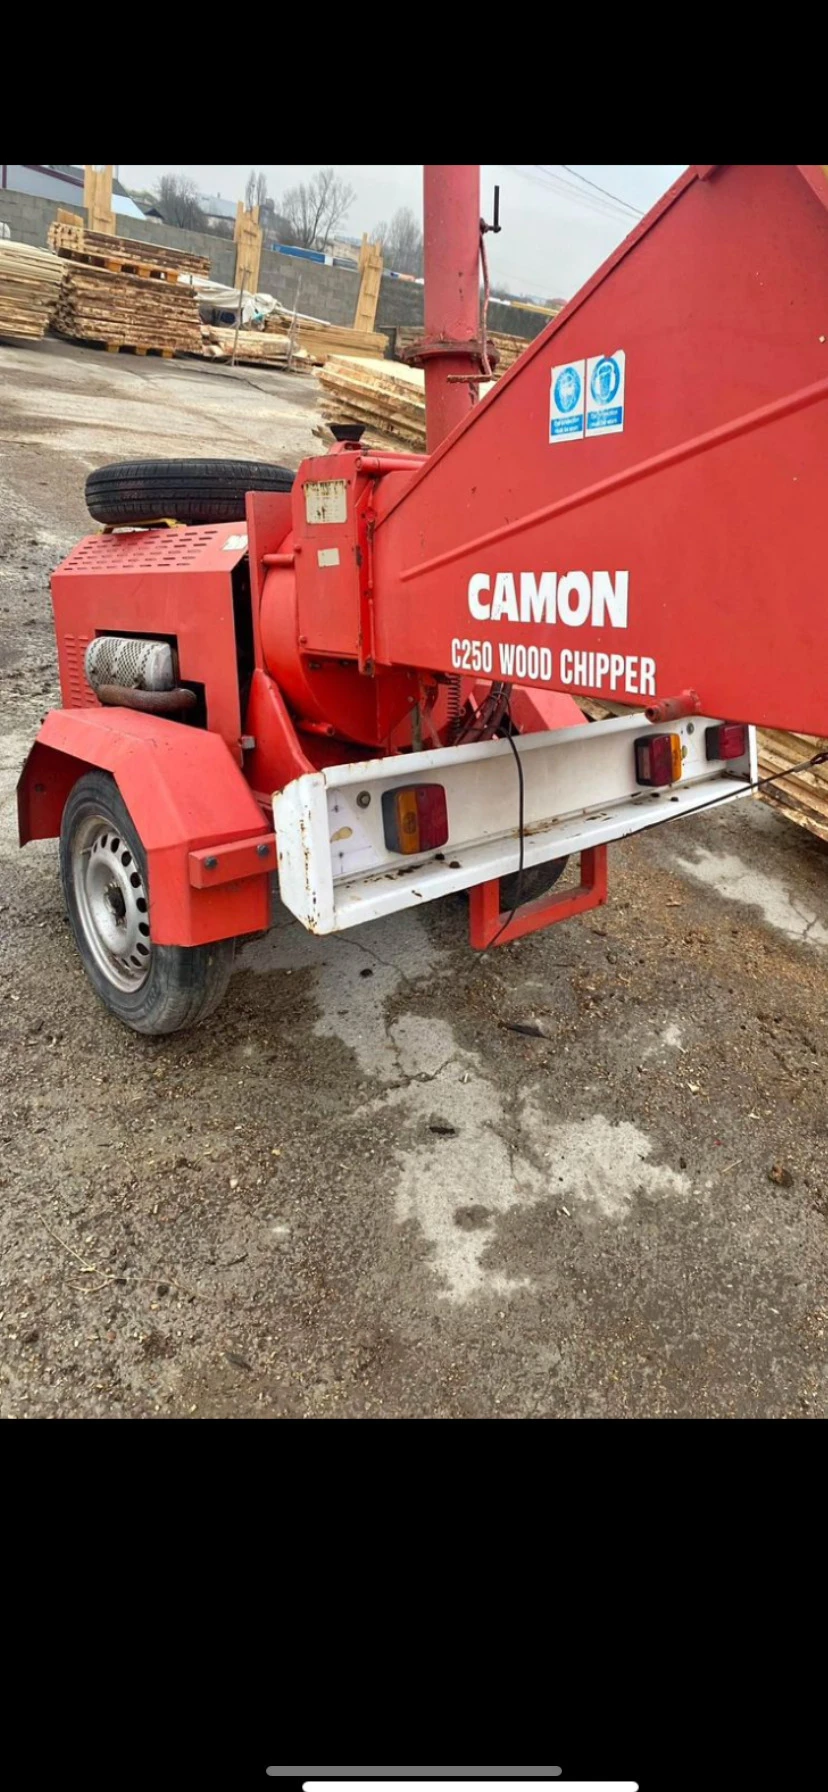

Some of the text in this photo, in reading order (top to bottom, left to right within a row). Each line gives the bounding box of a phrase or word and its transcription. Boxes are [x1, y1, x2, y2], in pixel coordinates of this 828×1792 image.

[468, 570, 629, 628] CAMON
[451, 638, 656, 696] C250 WOOD CHIPPER
